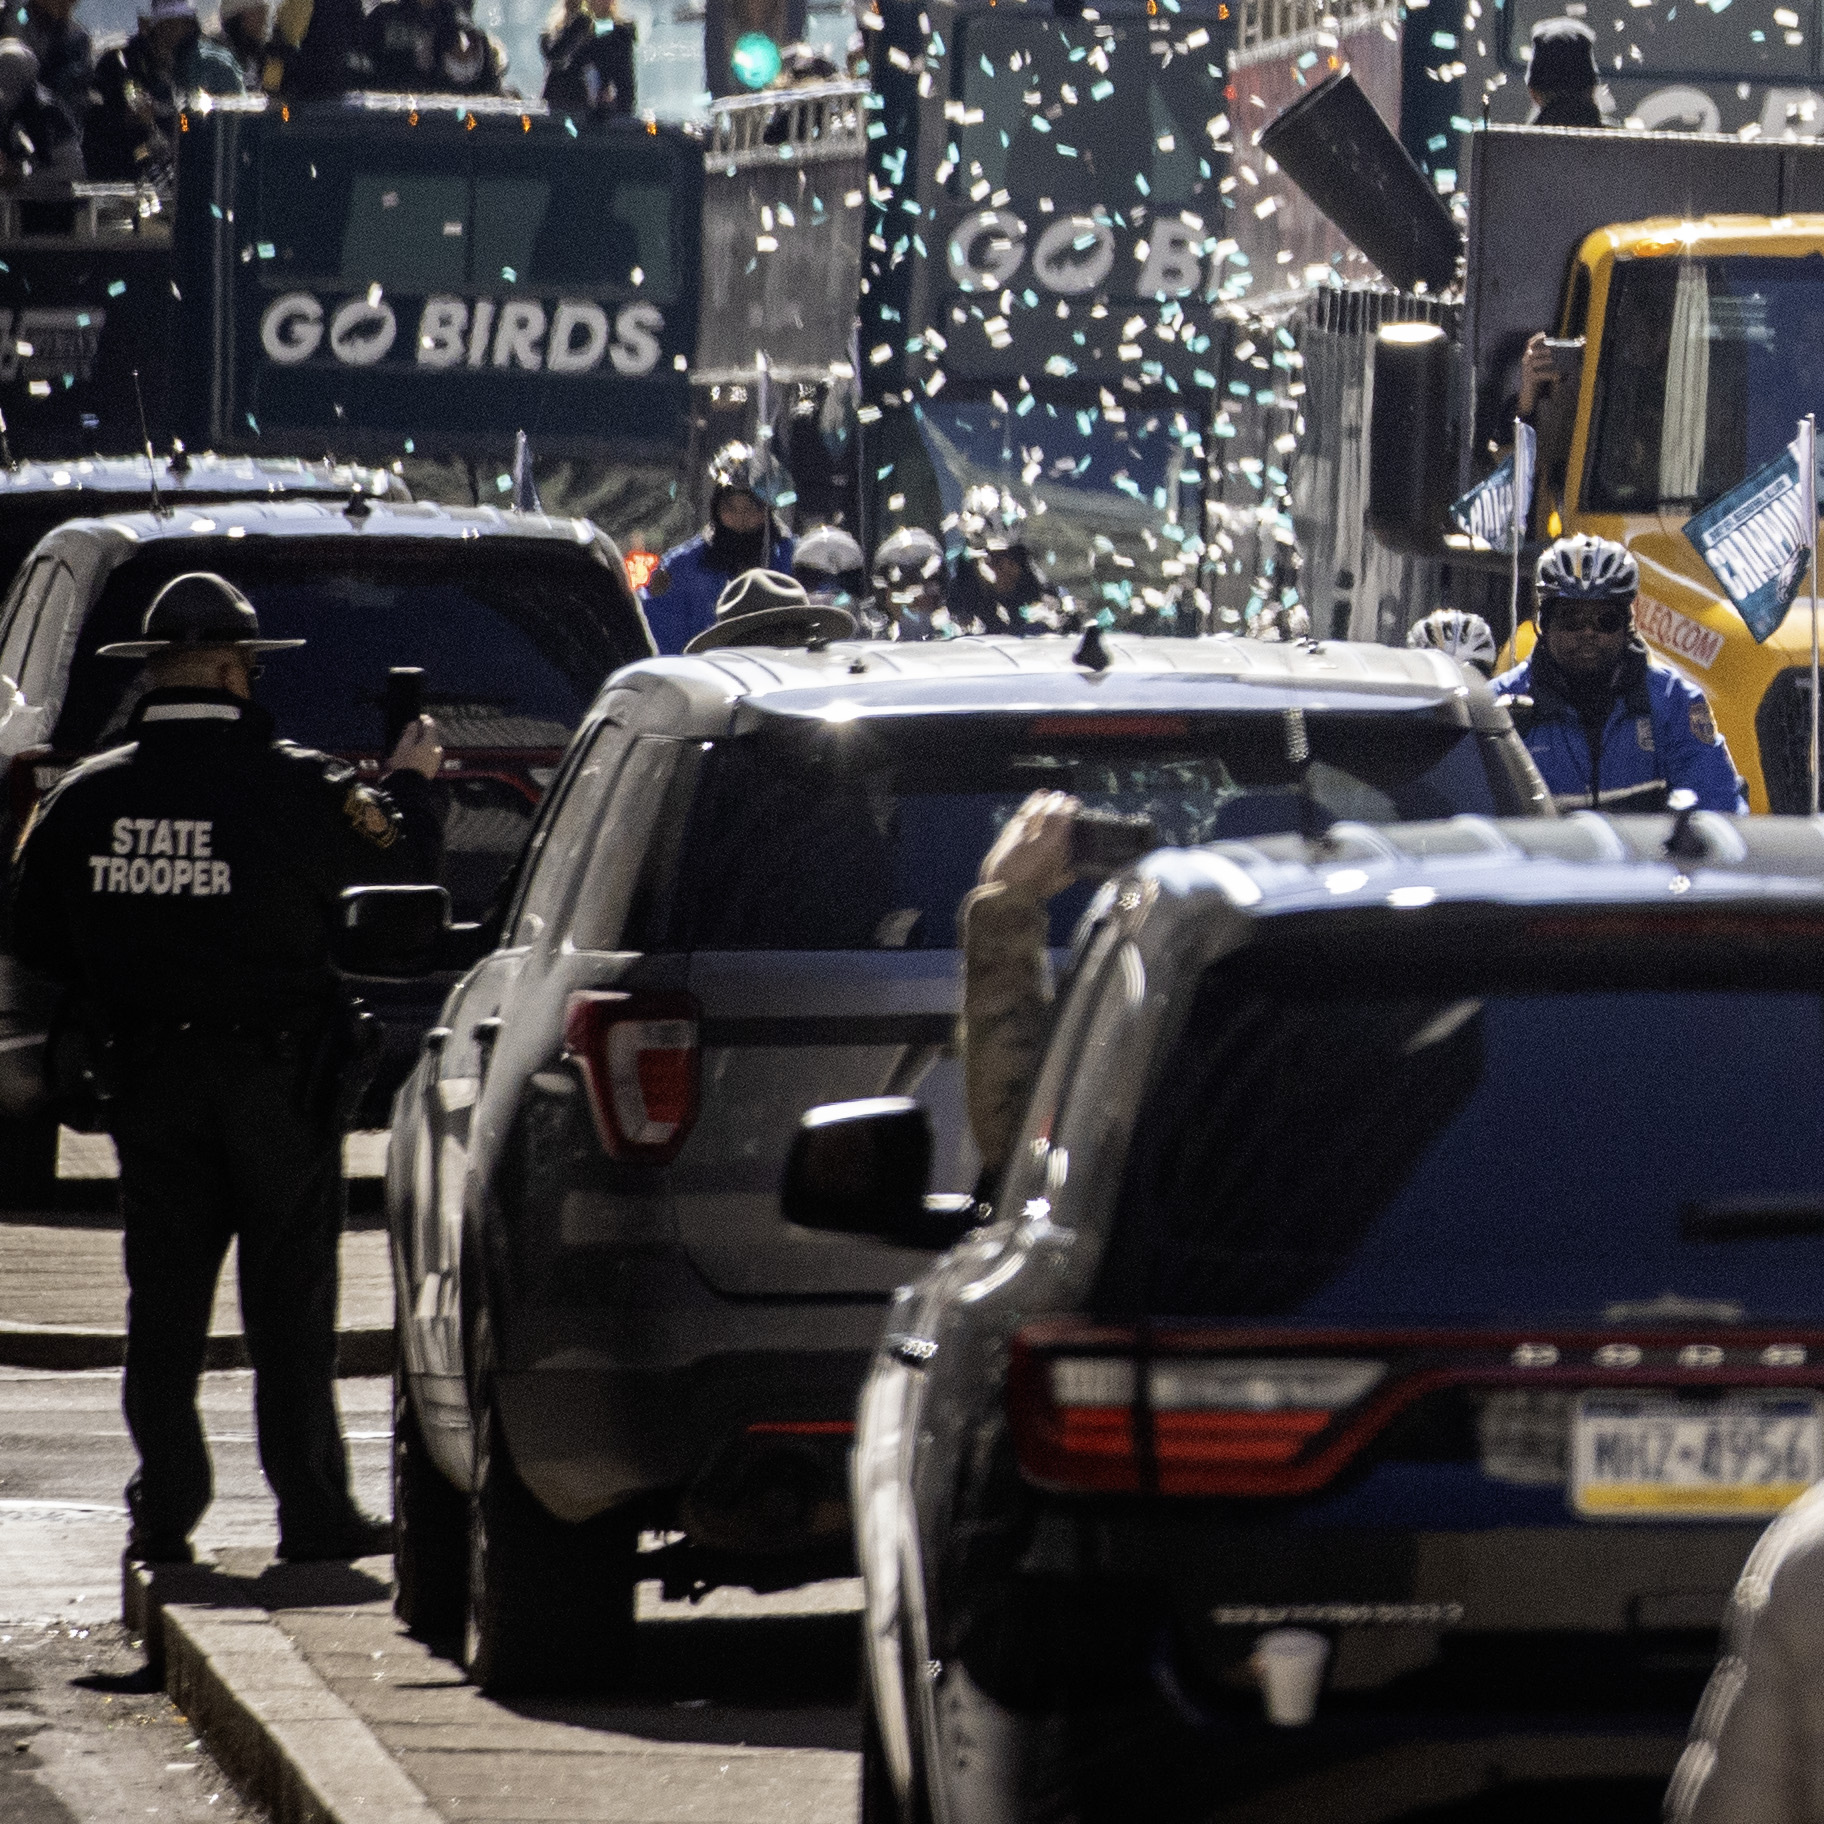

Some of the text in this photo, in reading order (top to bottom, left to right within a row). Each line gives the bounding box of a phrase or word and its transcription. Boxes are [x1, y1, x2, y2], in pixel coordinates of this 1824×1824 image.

[261, 292, 664, 375] GO BIRDS
[112, 816, 213, 858] STATE
[88, 855, 232, 896] TROOPER
